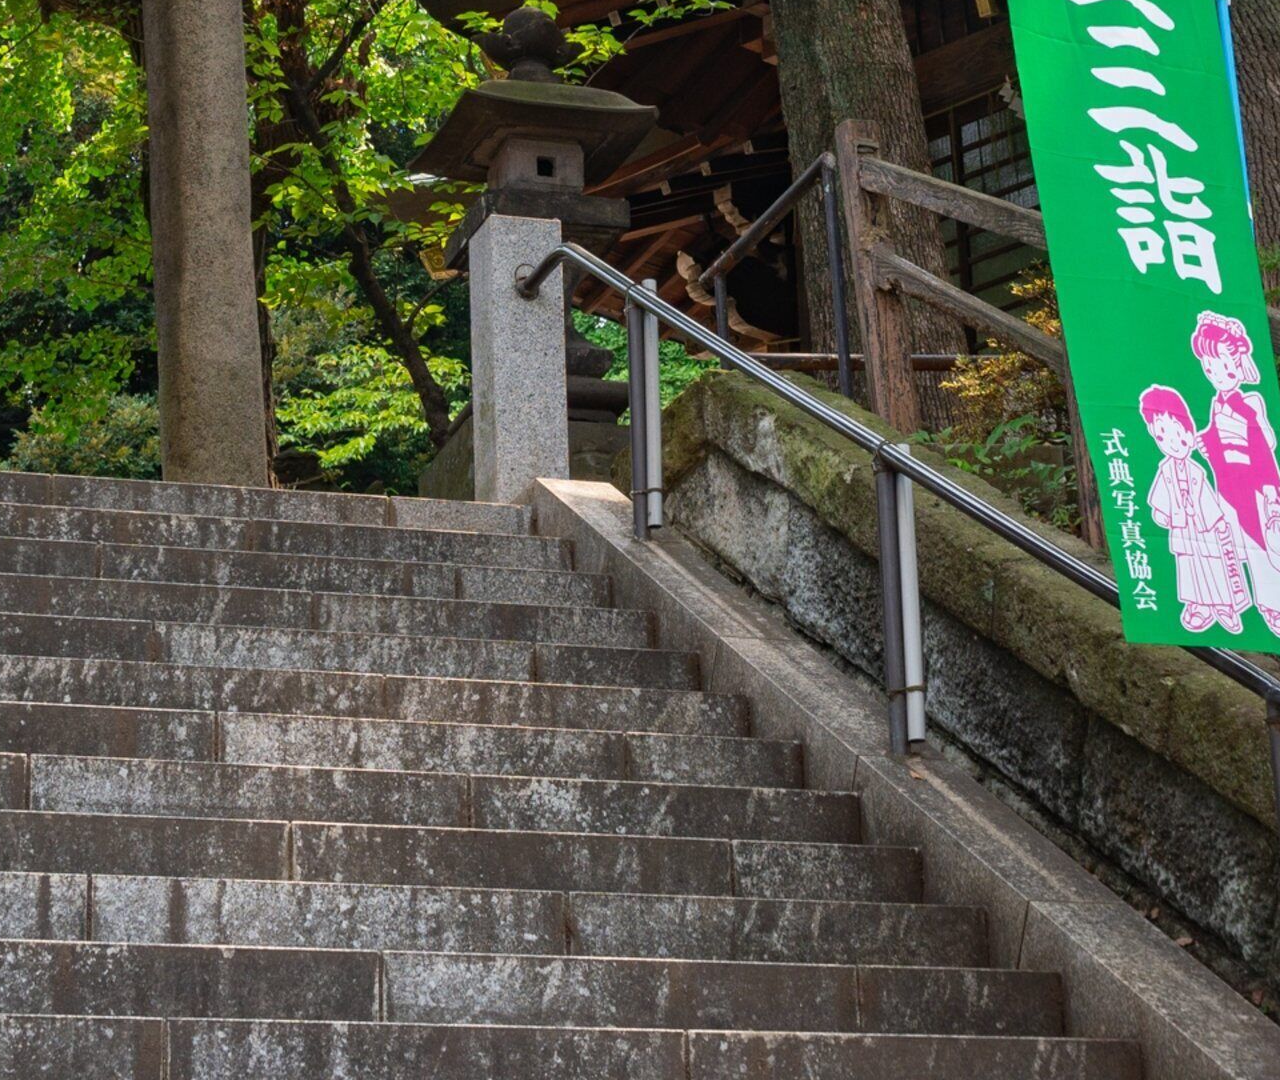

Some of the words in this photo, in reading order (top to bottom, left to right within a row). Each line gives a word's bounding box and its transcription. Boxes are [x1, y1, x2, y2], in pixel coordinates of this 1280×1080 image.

[1100, 428, 1157, 611] 式典写真協会
